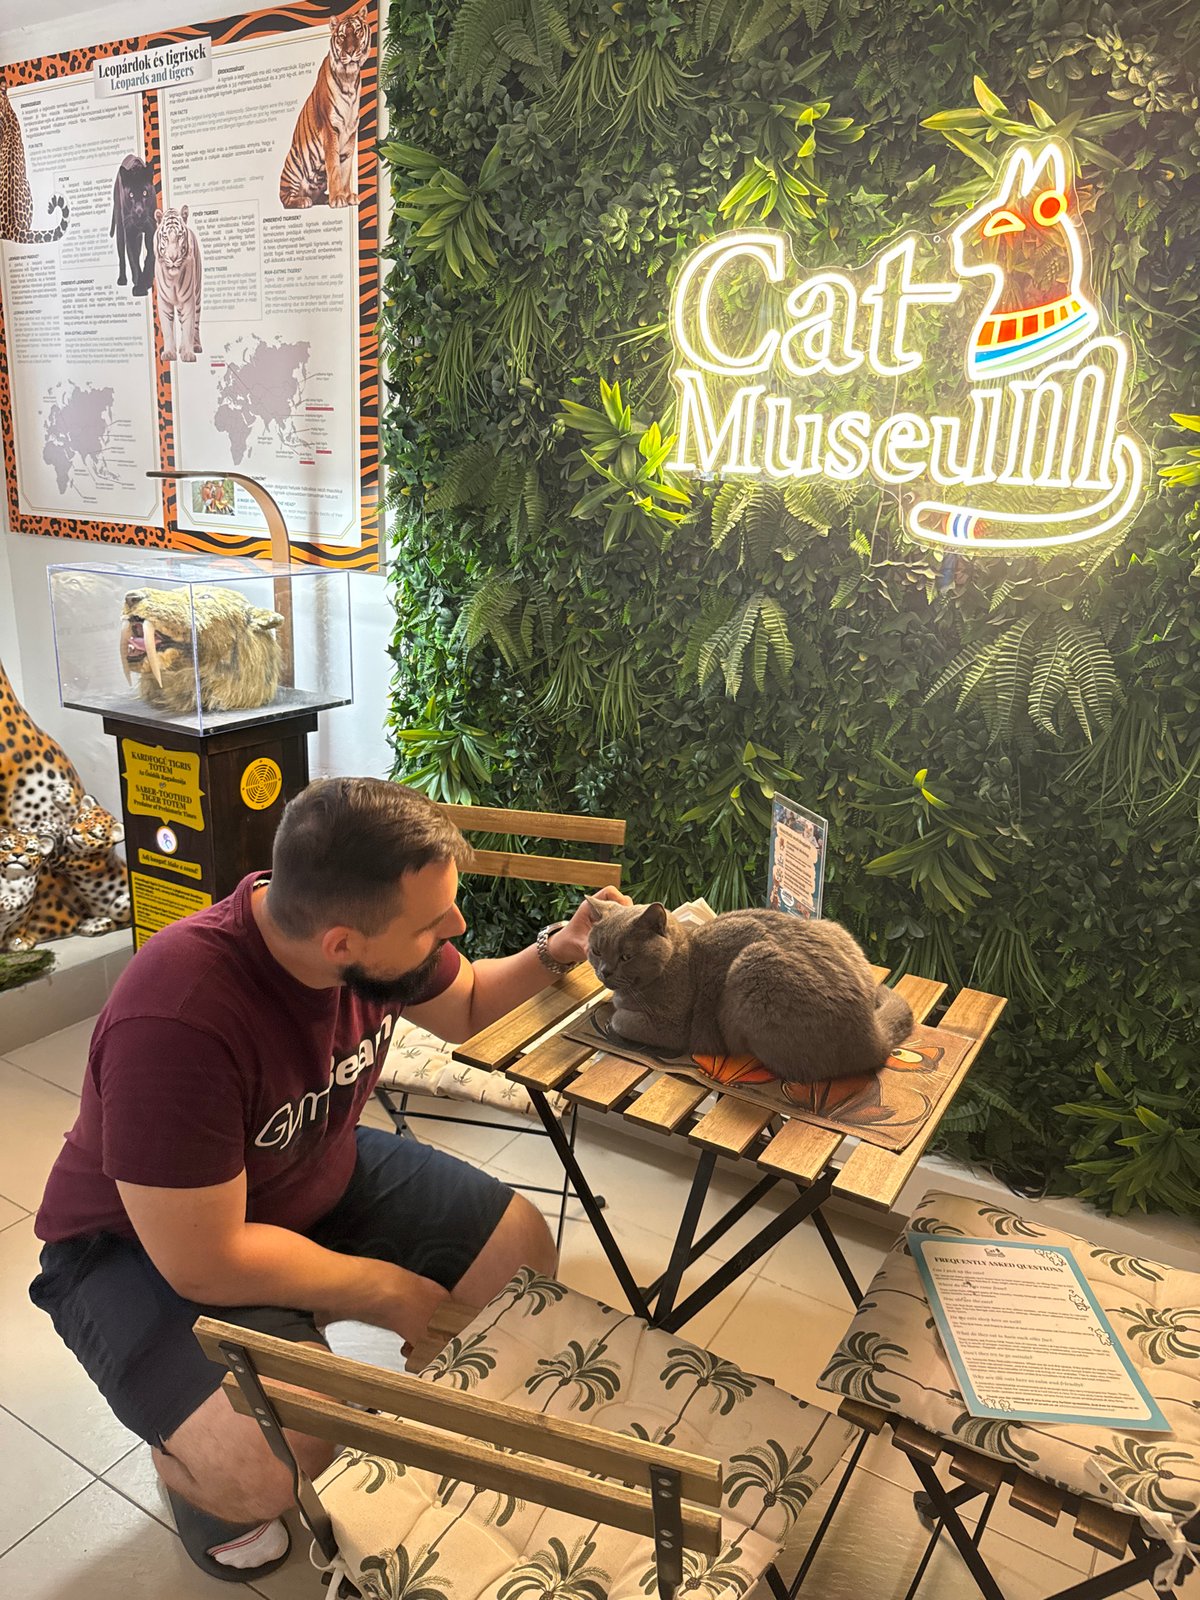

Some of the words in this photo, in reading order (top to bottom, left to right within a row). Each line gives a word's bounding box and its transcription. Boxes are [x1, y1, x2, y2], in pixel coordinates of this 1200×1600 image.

[98, 54, 151, 78] Leopárdok
[154, 52, 164, 67] és
[166, 44, 206, 68] tigrisek
[111, 72, 150, 91] Leopards
[152, 68, 168, 83] and
[170, 66, 194, 81] tigers
[673, 234, 961, 375] Cat
[667, 335, 1128, 490] Museum
[149, 763, 172, 775] TOTEM
[168, 759, 192, 771] TIGRIS
[135, 784, 192, 804] SABER-TOOTHED
[141, 794, 161, 804] TIGER
[162, 798, 186, 810] TOTEM
[934, 1257, 986, 1266] FREQUENTLY
[1016, 1263, 1064, 1273] QUESTIONS
